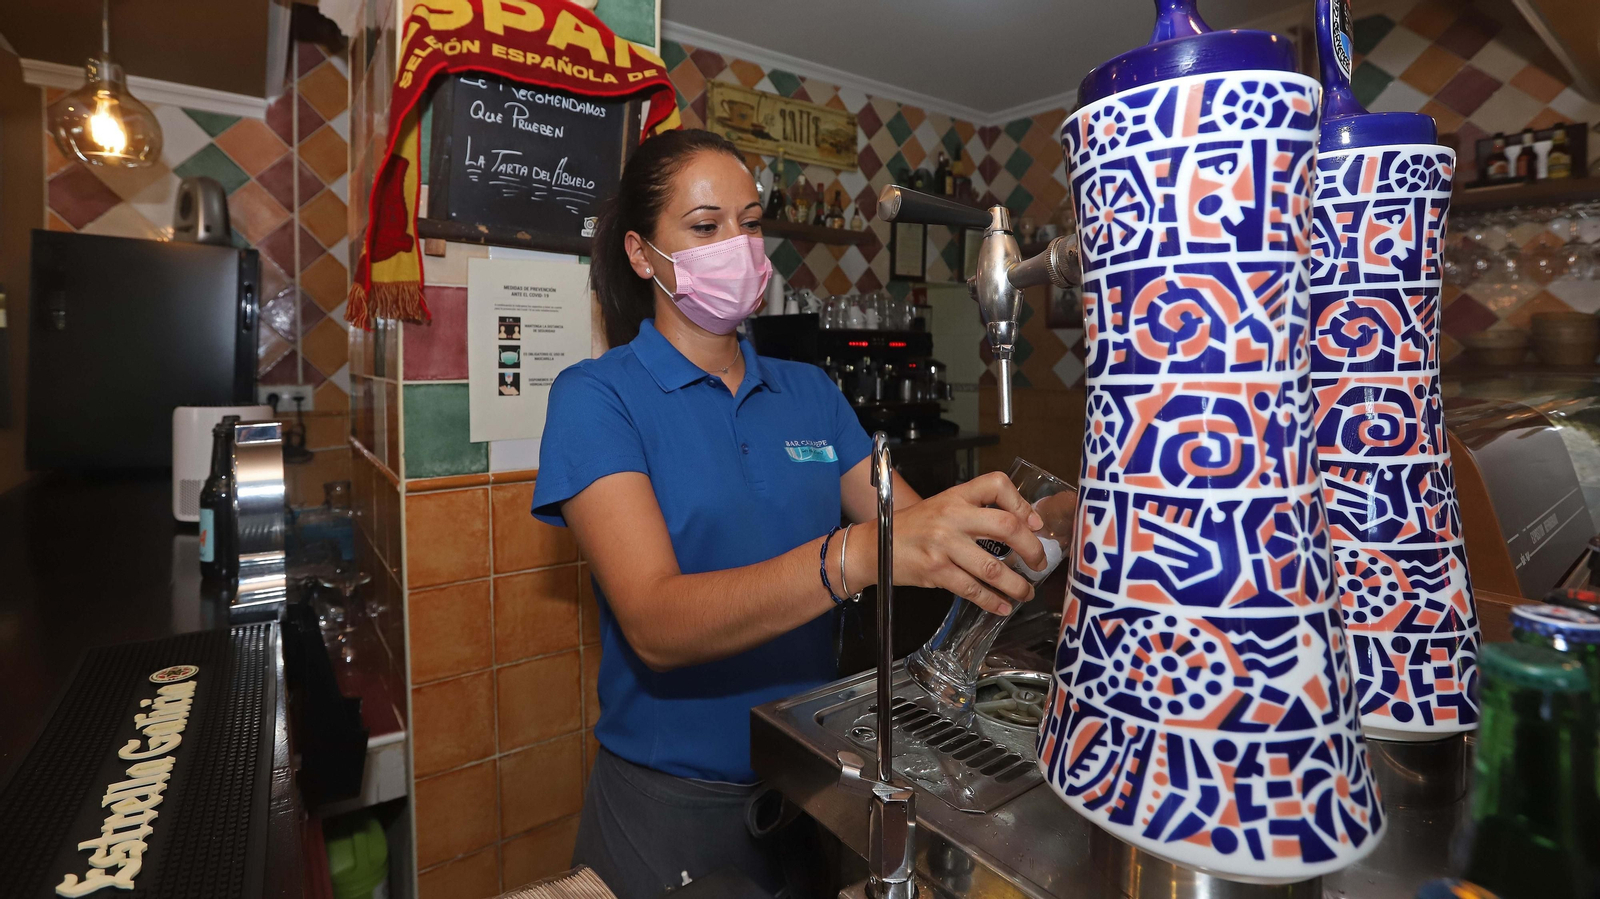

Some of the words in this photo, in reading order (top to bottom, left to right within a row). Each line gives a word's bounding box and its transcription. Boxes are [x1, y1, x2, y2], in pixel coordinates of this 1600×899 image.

[491, 42, 619, 84] ESPAÑOLA
[626, 69, 659, 82] DE
[55, 755, 177, 898] Estrella
[117, 680, 198, 760] Galicia
